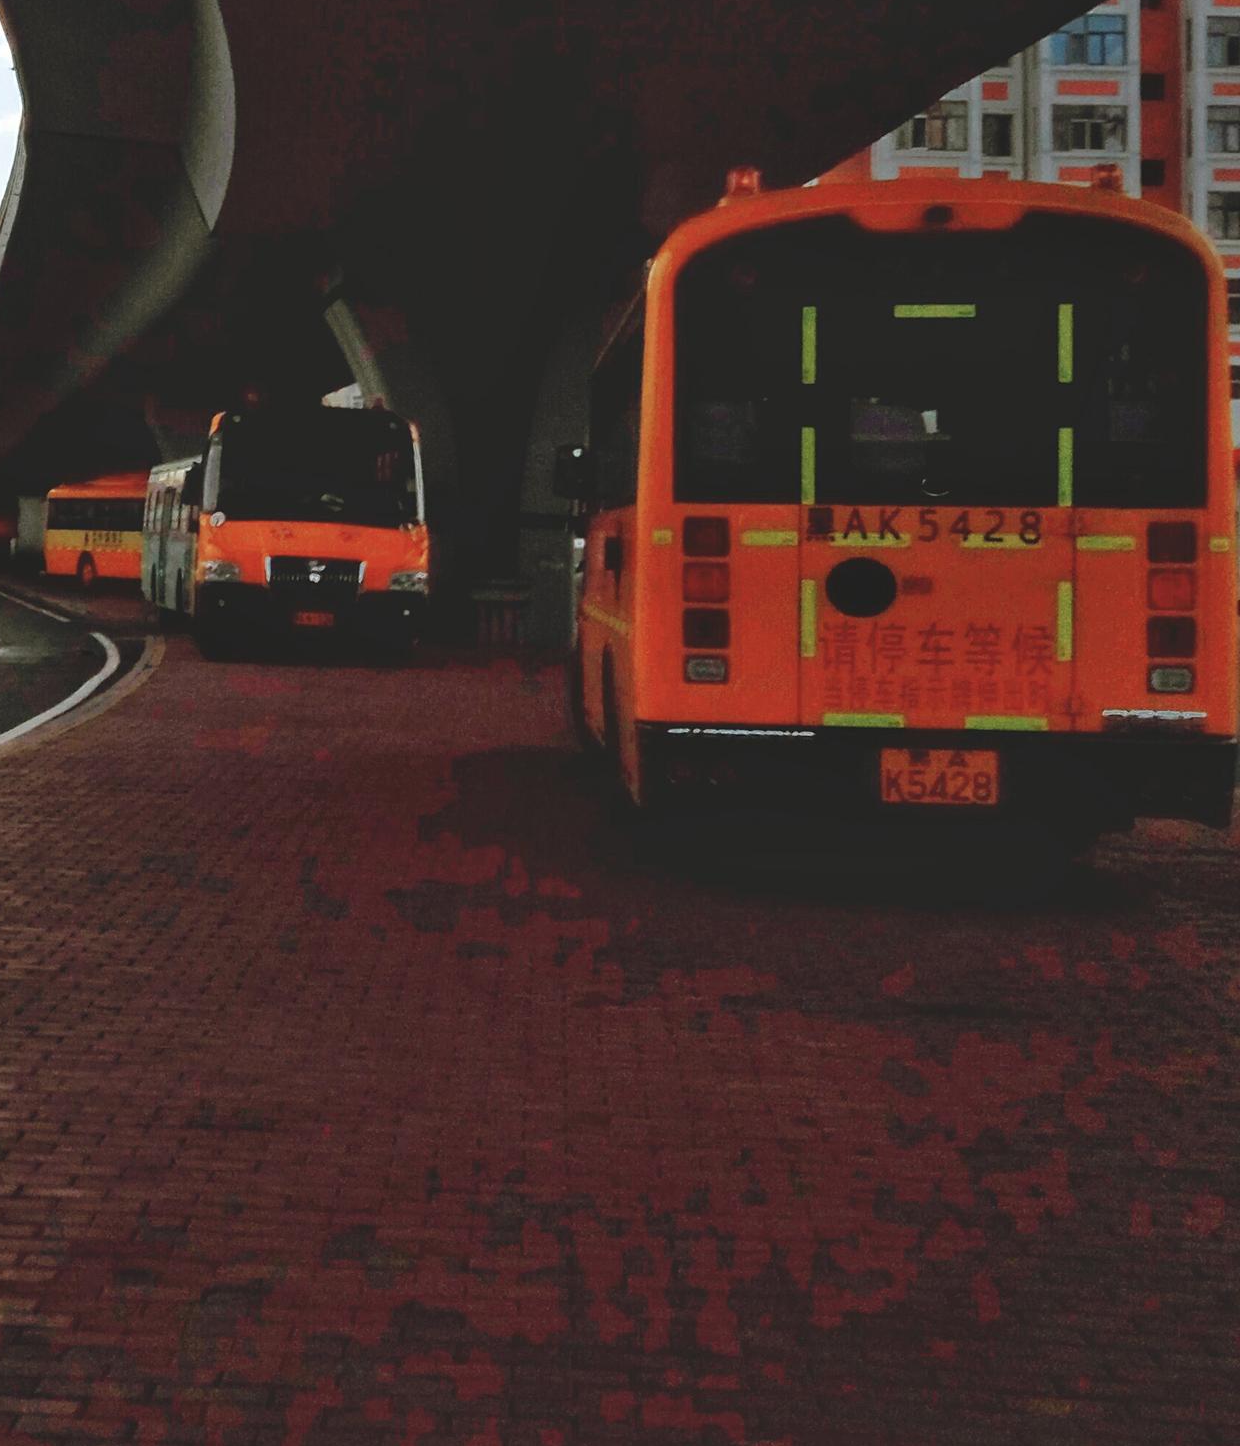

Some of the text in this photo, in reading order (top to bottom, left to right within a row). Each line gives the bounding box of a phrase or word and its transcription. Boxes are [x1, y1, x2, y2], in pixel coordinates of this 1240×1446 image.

[820, 621, 1054, 676] 请停车等候
[885, 769, 993, 802] K5428
